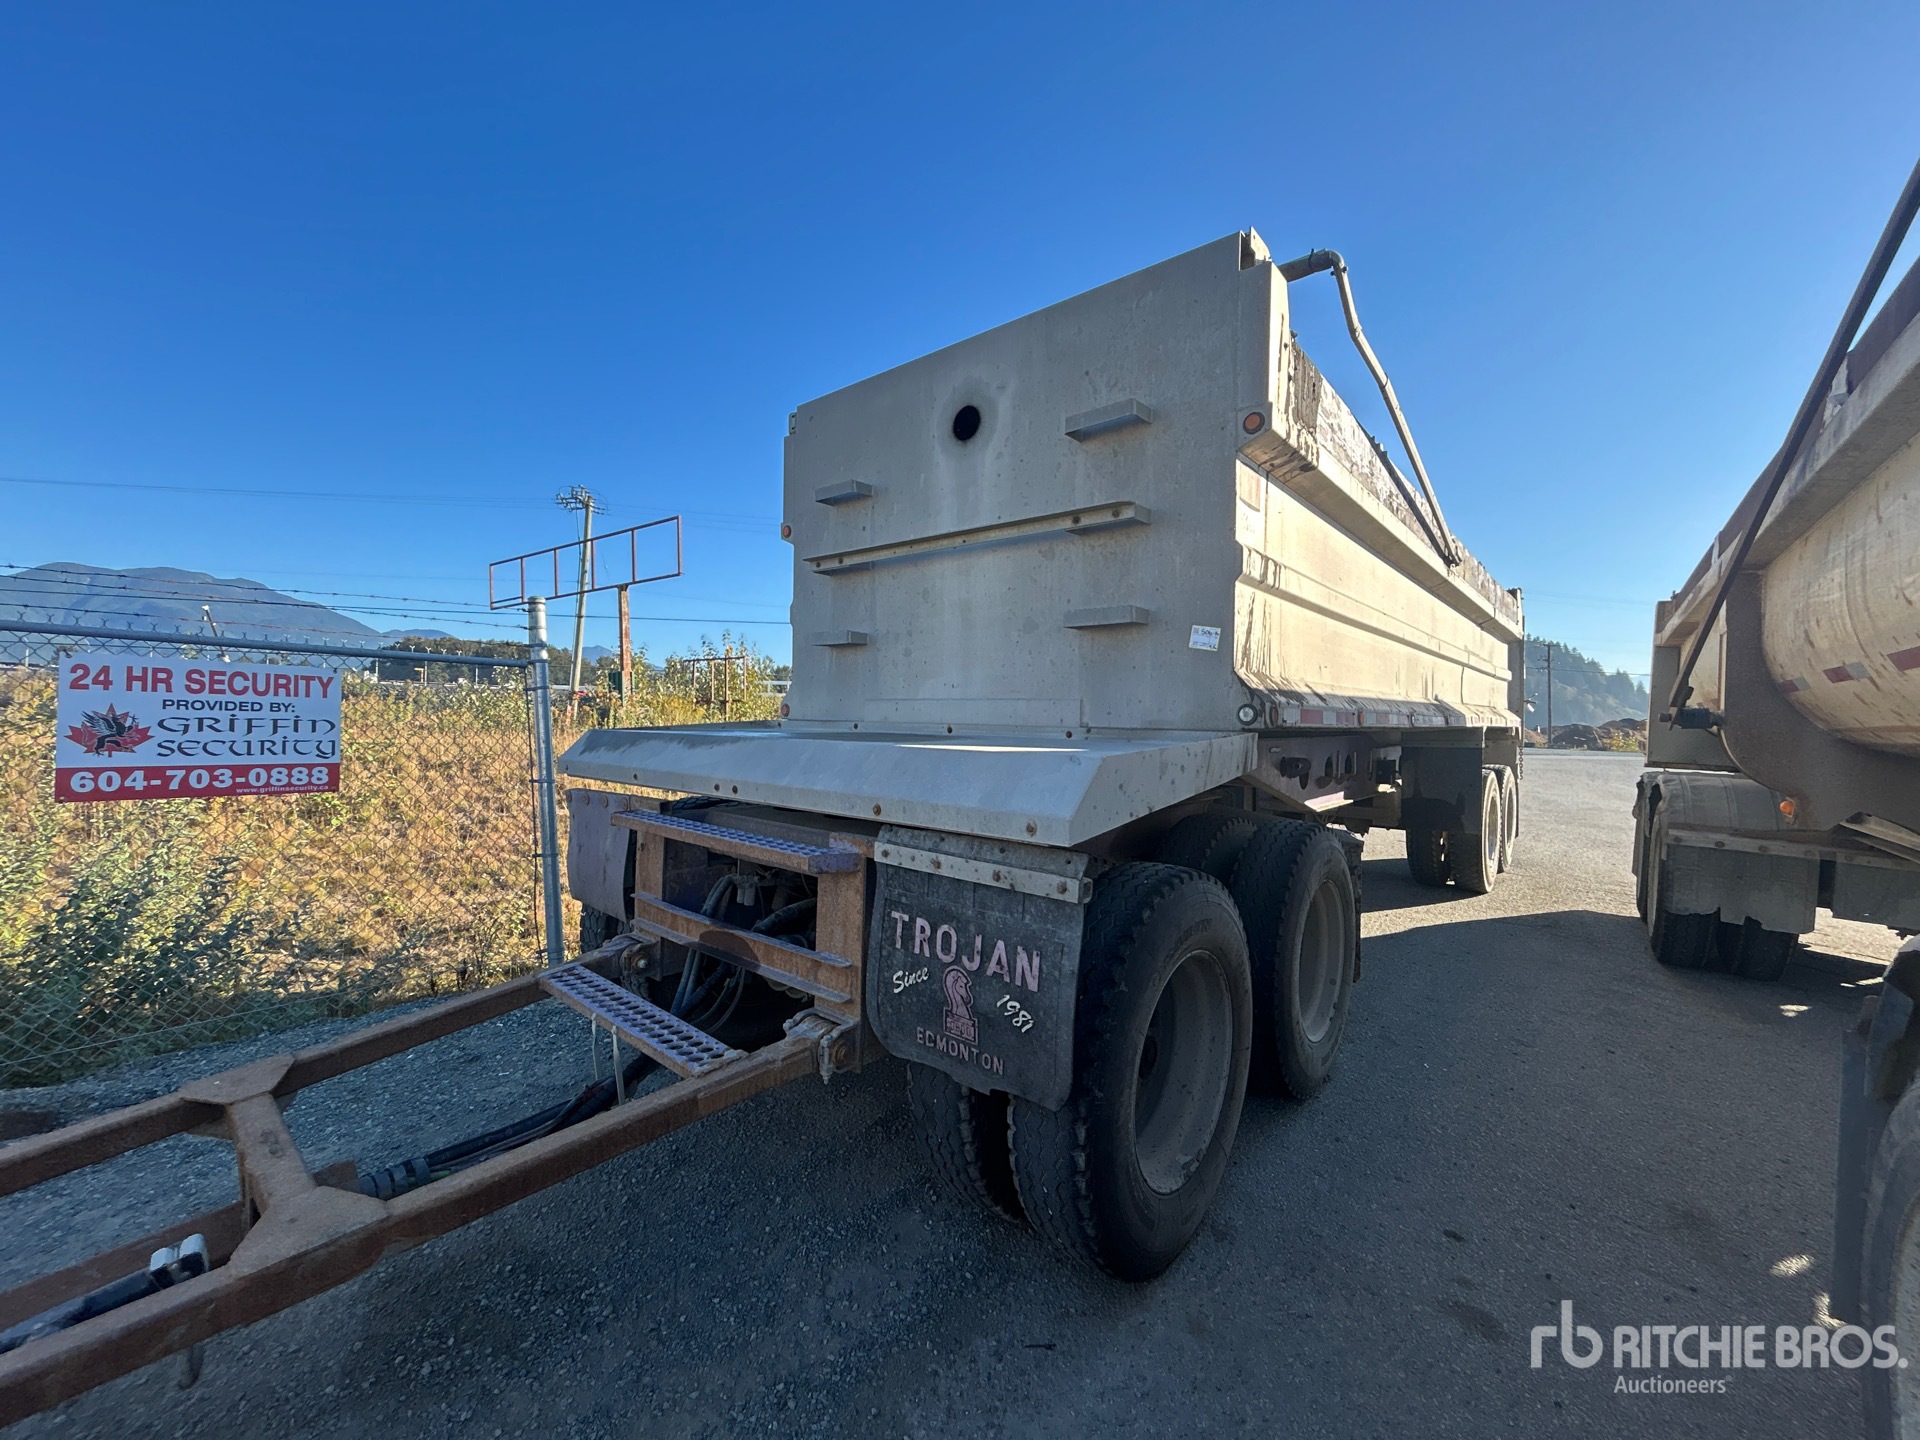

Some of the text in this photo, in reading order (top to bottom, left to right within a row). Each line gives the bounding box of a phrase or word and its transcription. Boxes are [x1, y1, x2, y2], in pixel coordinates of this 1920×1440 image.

[69, 663, 335, 699] 24 HR SECURITY
[161, 699, 296, 713] PROVIDED BY:
[70, 766, 329, 793] 604-703-0888
[236, 785, 329, 794] www.griffinsecurity.ca
[891, 910, 1041, 992] TROJAN
[893, 967, 930, 994] Since
[916, 1026, 1004, 1075] EDMONTON
